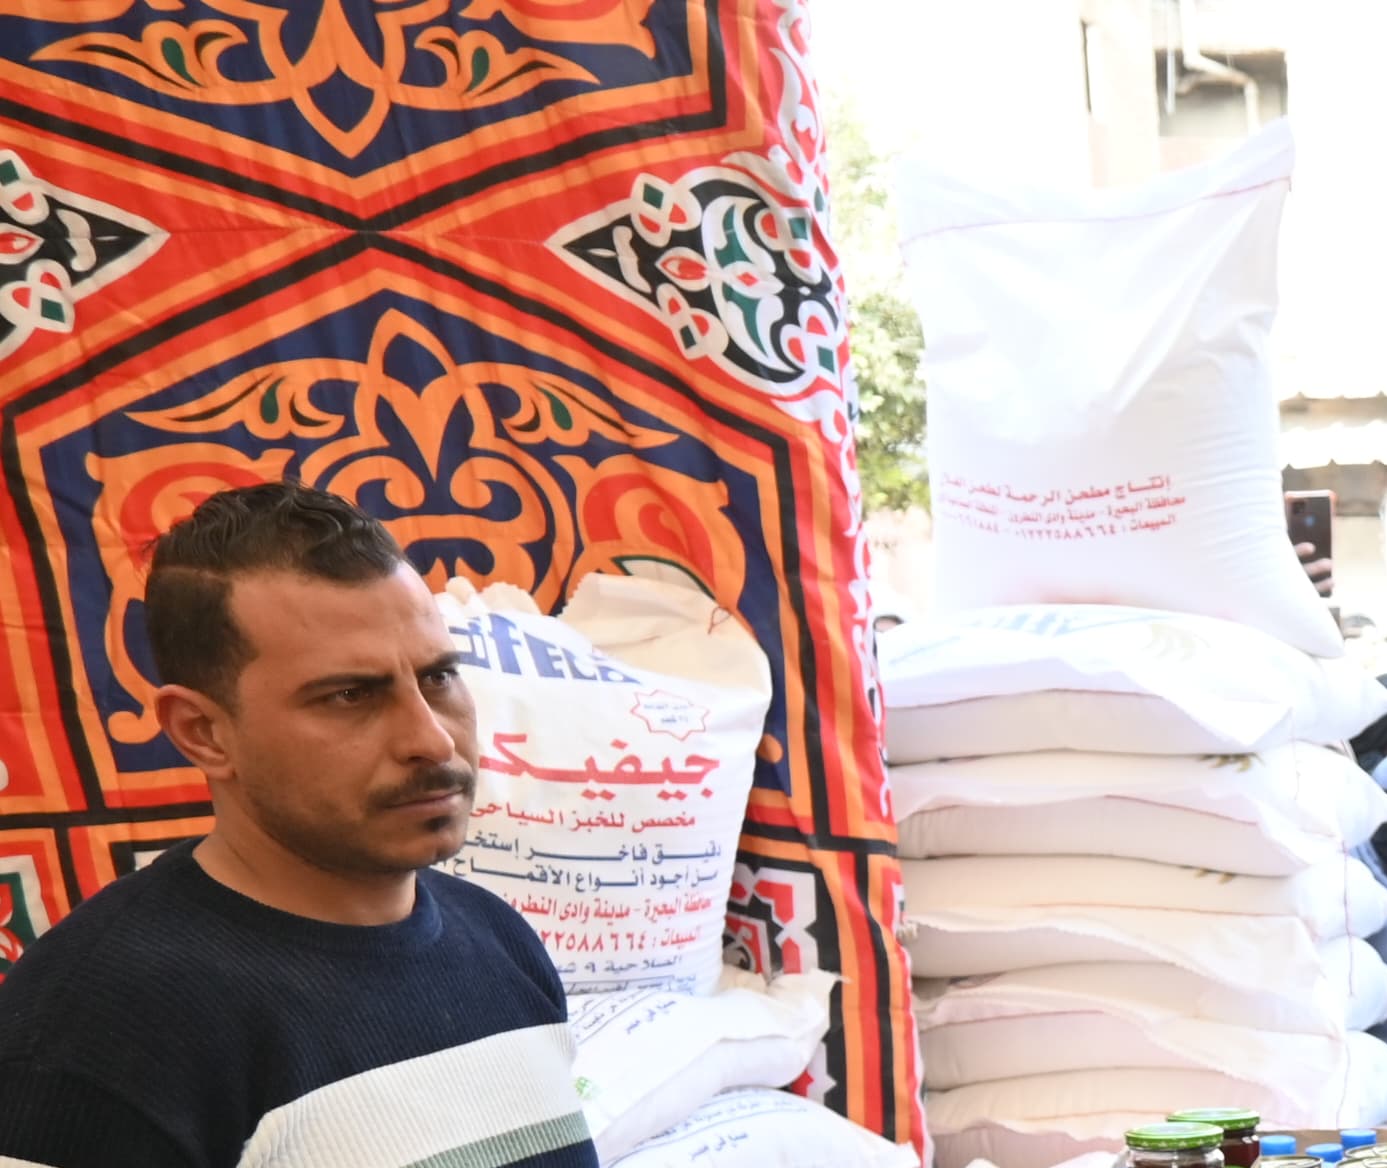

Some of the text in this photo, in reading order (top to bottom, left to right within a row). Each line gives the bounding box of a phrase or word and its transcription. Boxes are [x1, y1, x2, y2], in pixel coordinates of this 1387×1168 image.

[479, 732, 721, 801] جيفيك
[570, 811, 625, 833] للخبز
[631, 812, 696, 834] مخصص
[593, 900, 630, 925] مدينة
